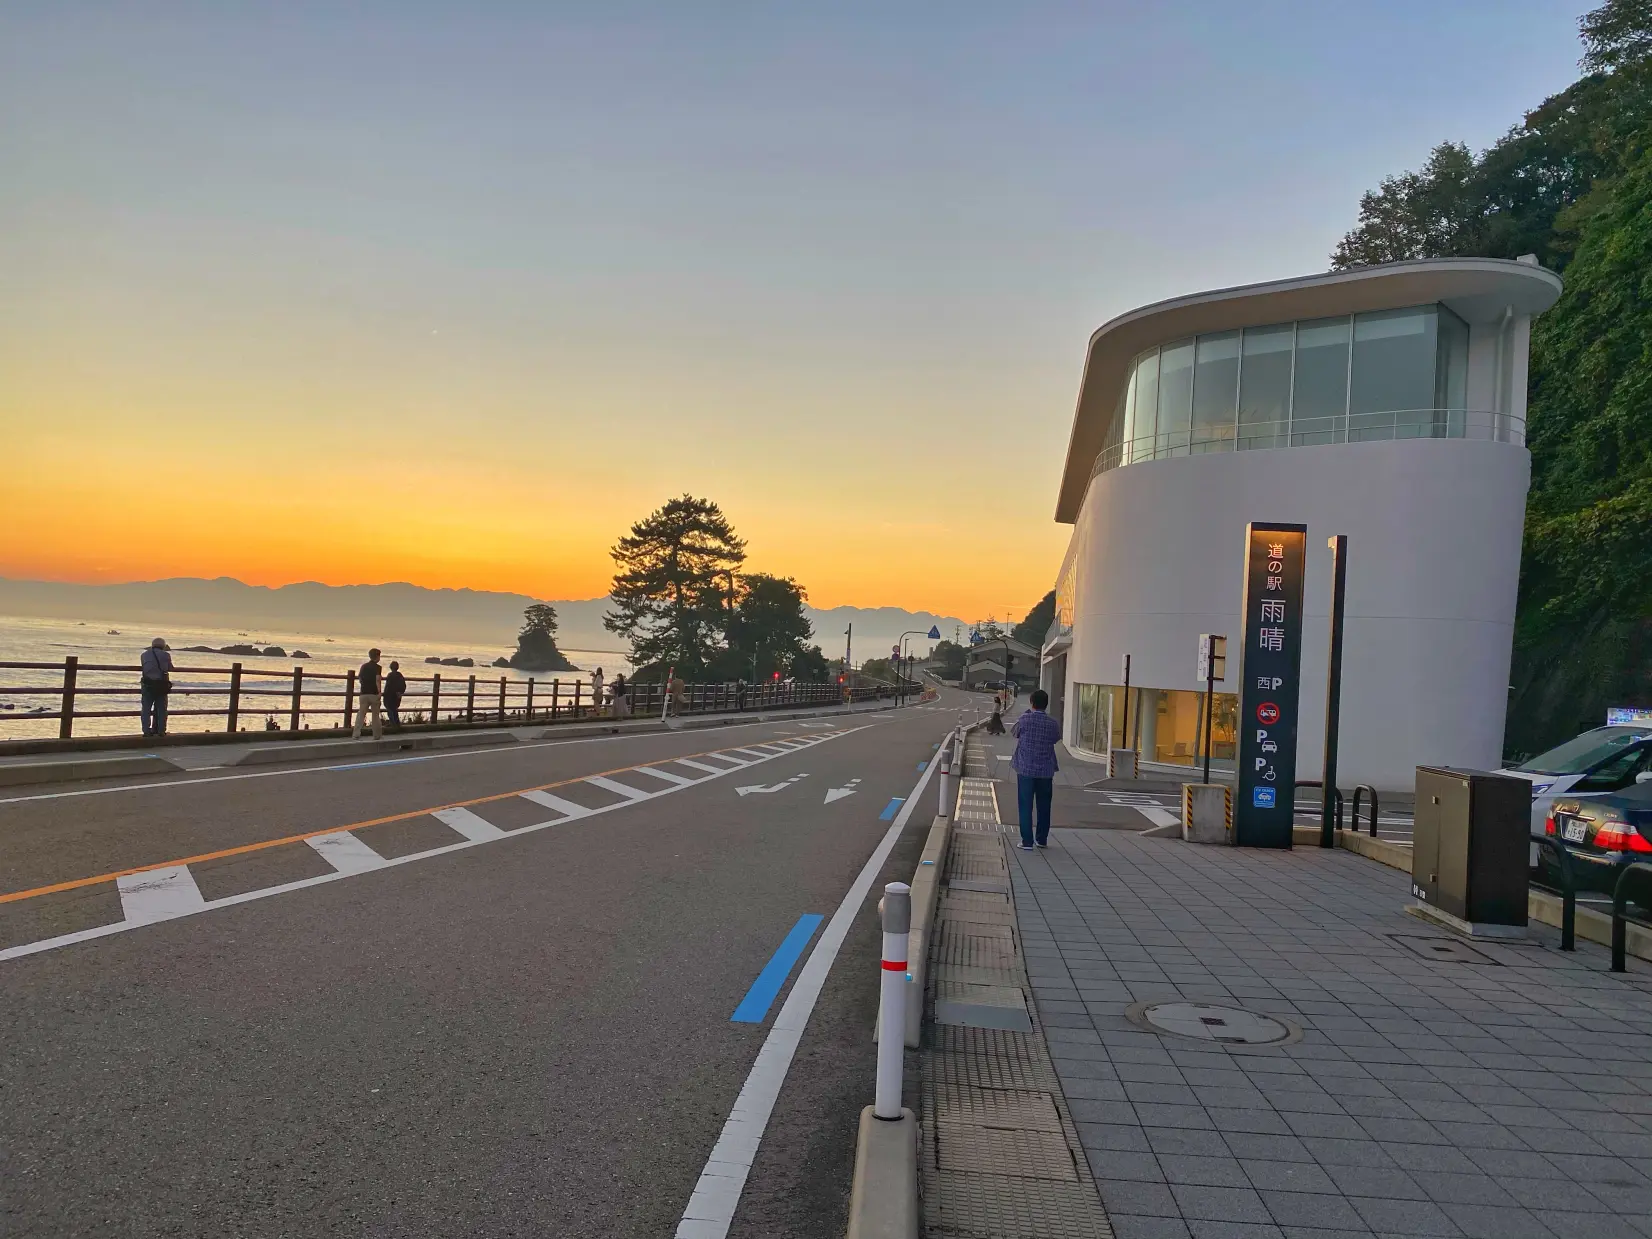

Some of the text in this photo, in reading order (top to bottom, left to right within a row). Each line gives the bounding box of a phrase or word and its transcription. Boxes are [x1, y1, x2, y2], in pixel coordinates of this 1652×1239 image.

[1267, 543, 1284, 590] 道の駅
[1259, 598, 1286, 651] 雨晴
[1257, 729, 1267, 743] P
[1255, 758, 1266, 771] P
